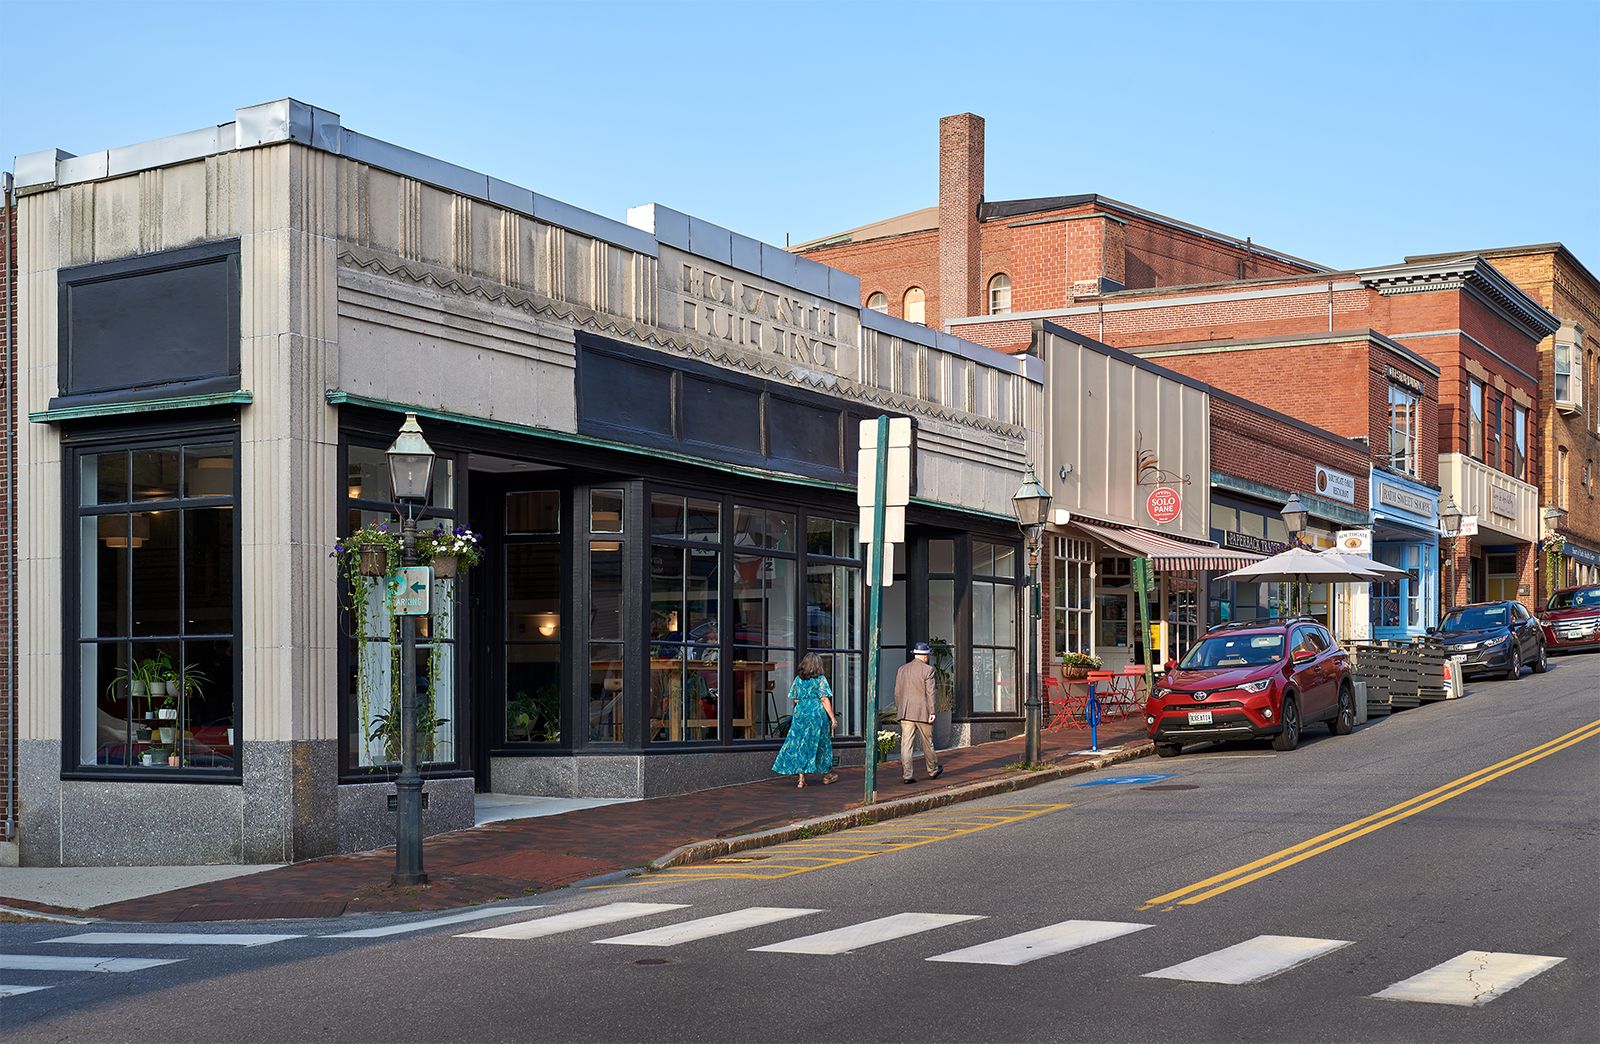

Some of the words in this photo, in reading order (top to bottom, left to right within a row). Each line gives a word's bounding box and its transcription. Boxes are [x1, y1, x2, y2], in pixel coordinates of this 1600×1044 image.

[695, 303, 828, 367] BUILDING
[1151, 497, 1175, 506] SOLO
[1154, 505, 1174, 513] PANE
[1229, 533, 1260, 551] PAPERBACK
